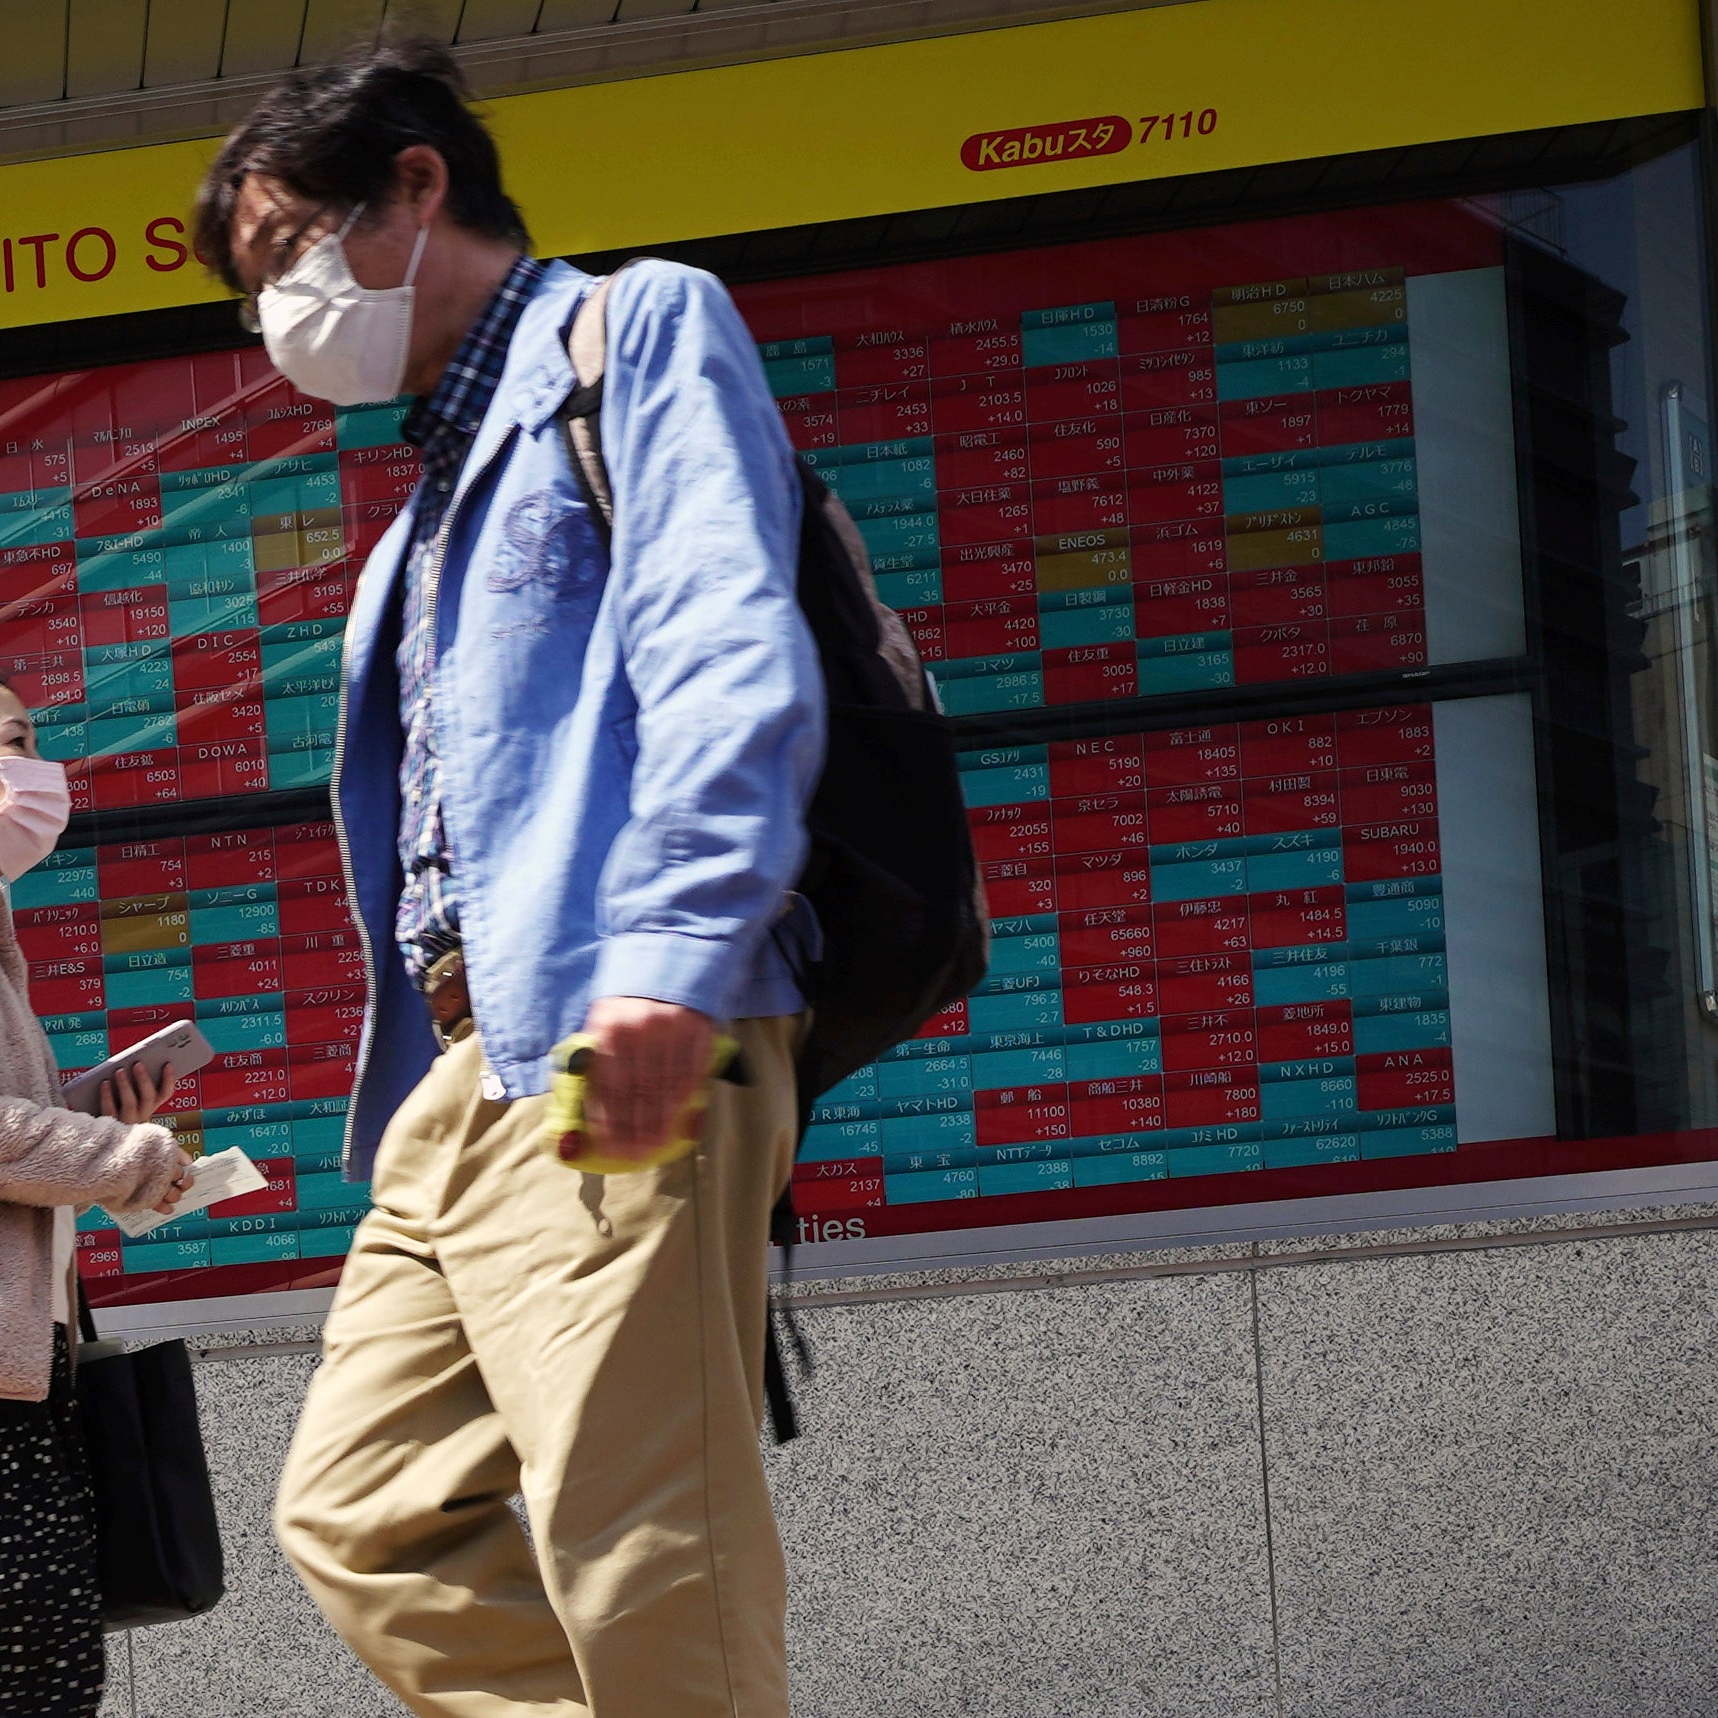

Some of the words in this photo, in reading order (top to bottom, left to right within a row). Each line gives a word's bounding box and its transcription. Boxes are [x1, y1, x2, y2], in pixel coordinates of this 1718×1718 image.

[1139, 108, 1218, 144] 7110
[1273, 300, 1304, 314] 6750
[1179, 312, 1208, 326] 1764
[893, 346, 923, 360] 3336
[1188, 368, 1212, 382] 985
[1087, 380, 1116, 394] 1026
[897, 402, 927, 416] 2453
[181, 415, 220, 431] INPEX
[1282, 414, 1311, 428] 1897
[215, 430, 244, 443] 1495
[1184, 425, 1215, 439] 7370
[1096, 437, 1119, 450] 590
[44, 453, 65, 466] 575
[994, 448, 1024, 461] 2460
[902, 458, 930, 472] 1082
[306, 473, 335, 487] 4453
[1187, 483, 1218, 496] 4122
[130, 496, 157, 510] 1893
[1092, 493, 1122, 507] 7612
[1059, 534, 1105, 549] ENEOS
[1192, 539, 1221, 553] 1619
[133, 551, 161, 565] 5490
[51, 562, 76, 576] 697
[1001, 560, 1031, 574] 3470
[314, 584, 342, 597] 3195
[130, 605, 164, 620] 19150
[48, 616, 76, 630] 3540
[1004, 617, 1034, 630] 4420
[228, 649, 256, 663] 2554
[1102, 663, 1133, 677] 3005
[232, 704, 260, 717] 3420
[1308, 736, 1331, 748] 882
[198, 742, 246, 758] DOWA
[1199, 746, 1235, 760] 18405
[235, 758, 264, 772] 6010
[1109, 756, 1139, 769] 5190
[146, 769, 175, 782] 6503
[1400, 783, 1432, 796] 9030
[1112, 813, 1142, 826] 7002
[1009, 823, 1047, 837] 22055
[1361, 823, 1418, 839] SUBARU
[249, 849, 270, 861] 215
[1307, 848, 1341, 862] 4190
[160, 859, 181, 871] 754
[58, 869, 93, 882] 22975
[1123, 870, 1146, 882] 896
[239, 904, 274, 918] 12900
[157, 913, 185, 926] 1180
[1214, 917, 1245, 930] 4217
[1111, 926, 1149, 940] 65660
[248, 959, 275, 972] 4011
[167, 968, 188, 980] 754
[1217, 974, 1248, 986] 4166
[79, 978, 100, 990] 379
[1225, 1087, 1255, 1099] 7800
[1122, 1096, 1159, 1110] 10380
[1028, 1105, 1065, 1119] 11100
[850, 1179, 879, 1192] 2137
[266, 1234, 295, 1246] 4066
[178, 1242, 206, 1255] 3587
